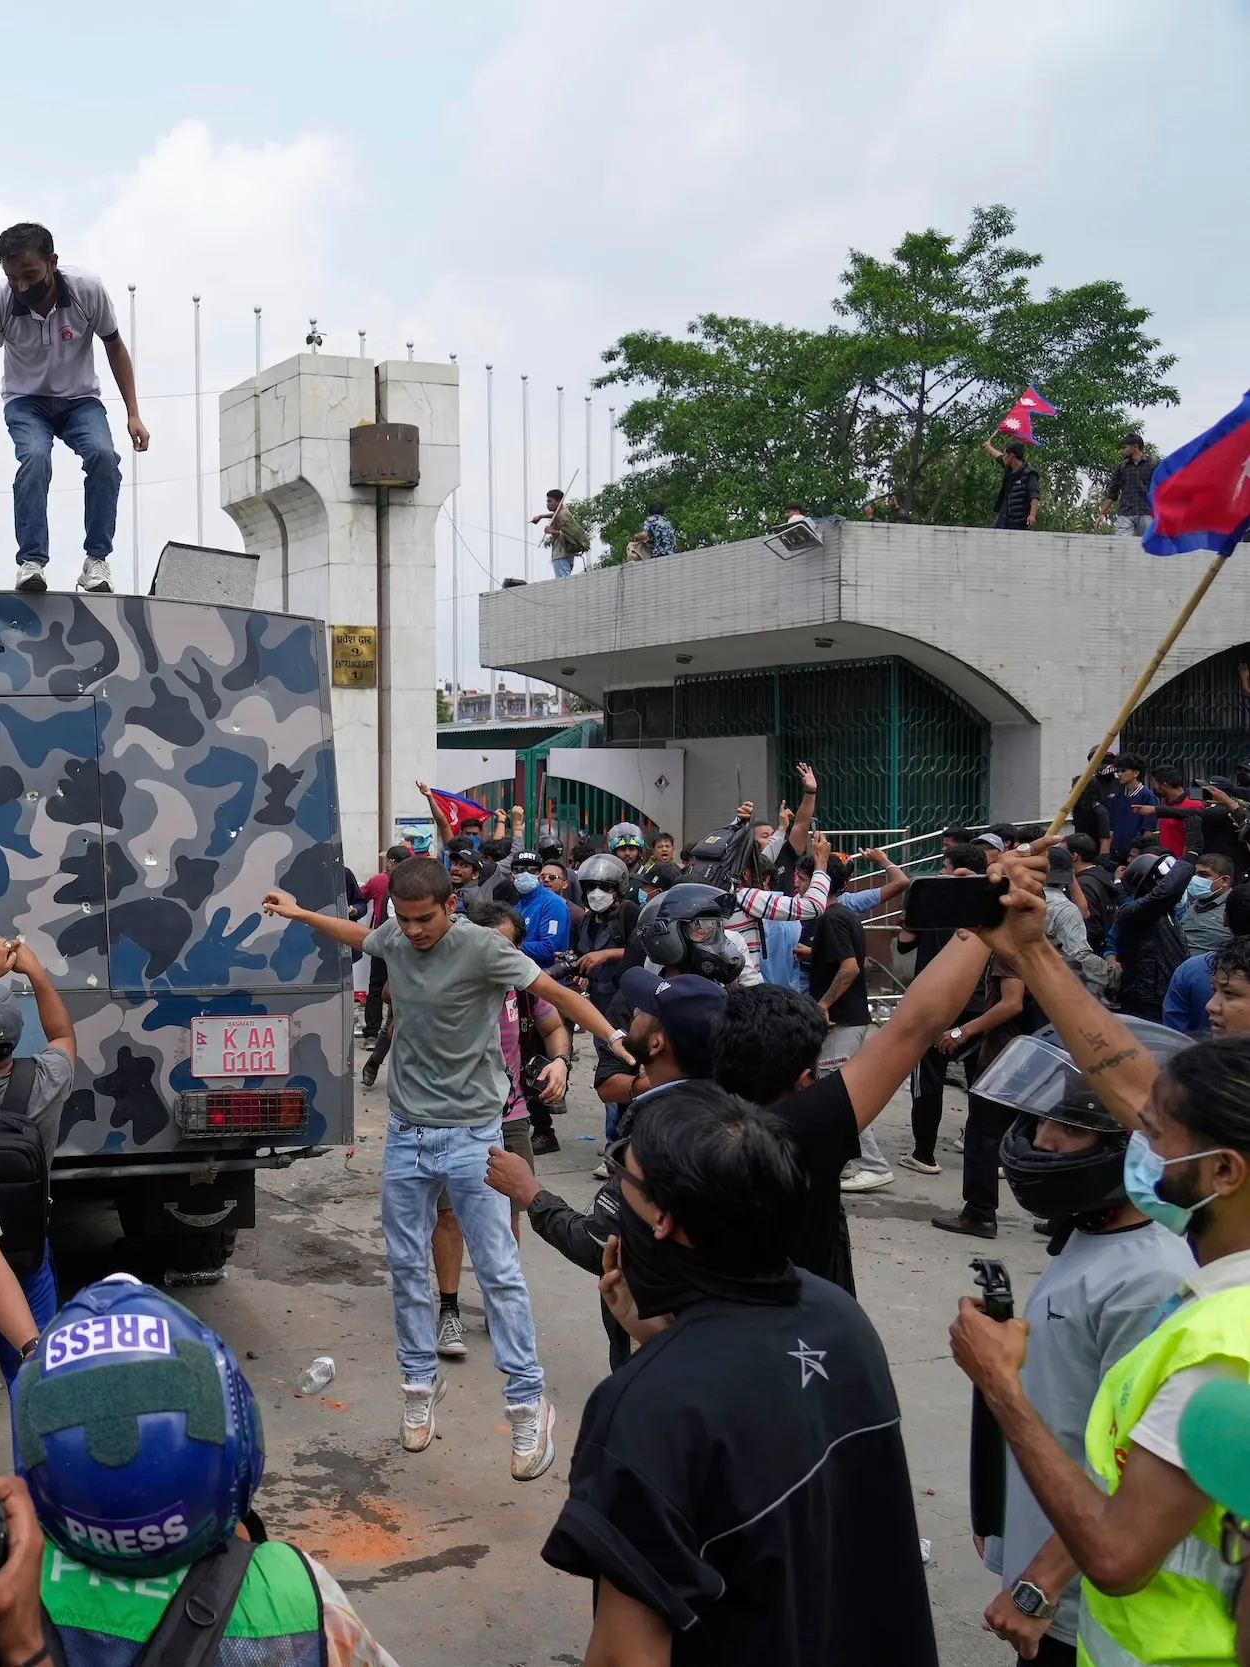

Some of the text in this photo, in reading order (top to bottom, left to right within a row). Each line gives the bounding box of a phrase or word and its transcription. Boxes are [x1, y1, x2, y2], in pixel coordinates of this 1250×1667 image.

[336, 633, 373, 646] प्रवेश द्वार
[335, 660, 374, 669] ENTRANCE GATE
[704, 835, 722, 844] CAT
[518, 852, 536, 860] OBEY
[520, 1017, 528, 1033] EOS
[224, 1027, 276, 1049] K AA
[223, 1050, 276, 1072] 0101
[50, 1316, 166, 1364] PRESS
[65, 1514, 188, 1554] PRESS
